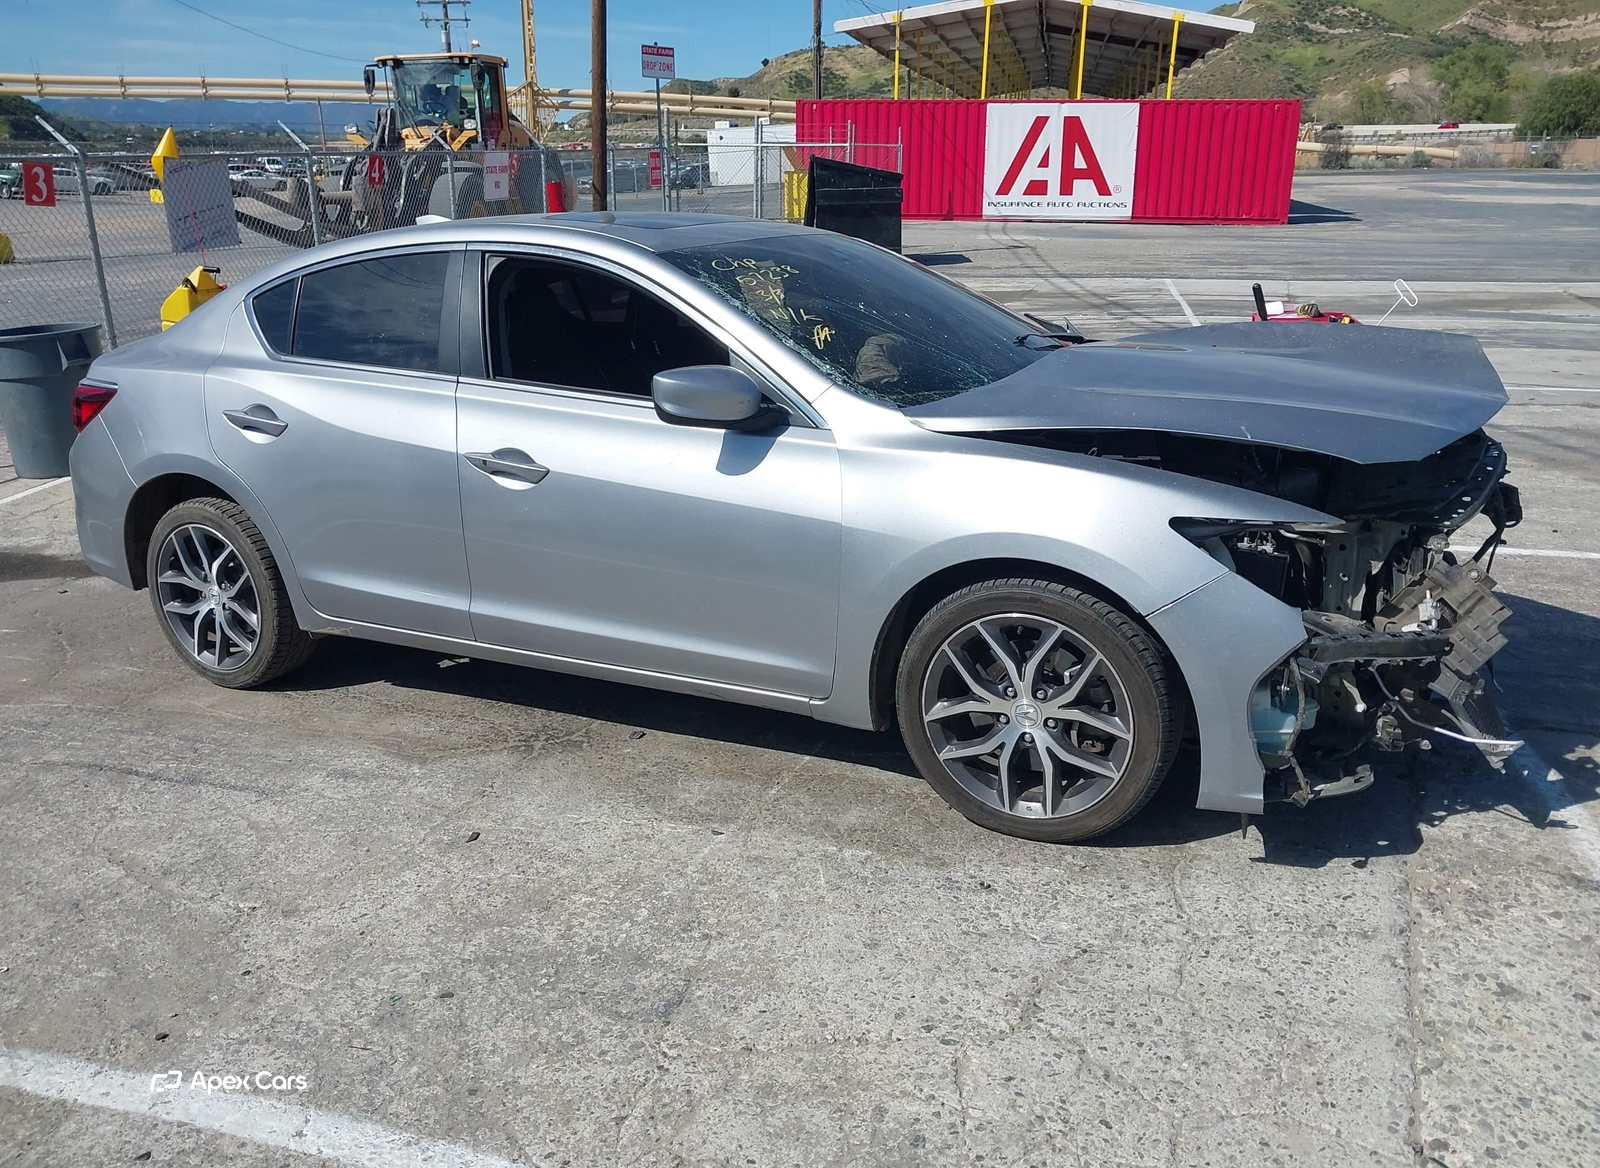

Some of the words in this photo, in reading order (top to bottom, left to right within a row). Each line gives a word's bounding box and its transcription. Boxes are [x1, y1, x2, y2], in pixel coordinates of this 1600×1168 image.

[643, 61, 657, 70] DROP
[659, 62, 673, 72] ZONE
[372, 158, 379, 182] 4
[486, 166, 498, 174] STATE
[31, 166, 47, 202] 3
[987, 200, 1043, 208] INSURANCE
[1047, 200, 1073, 208] AUTO
[1077, 201, 1128, 209] AUCTIONS
